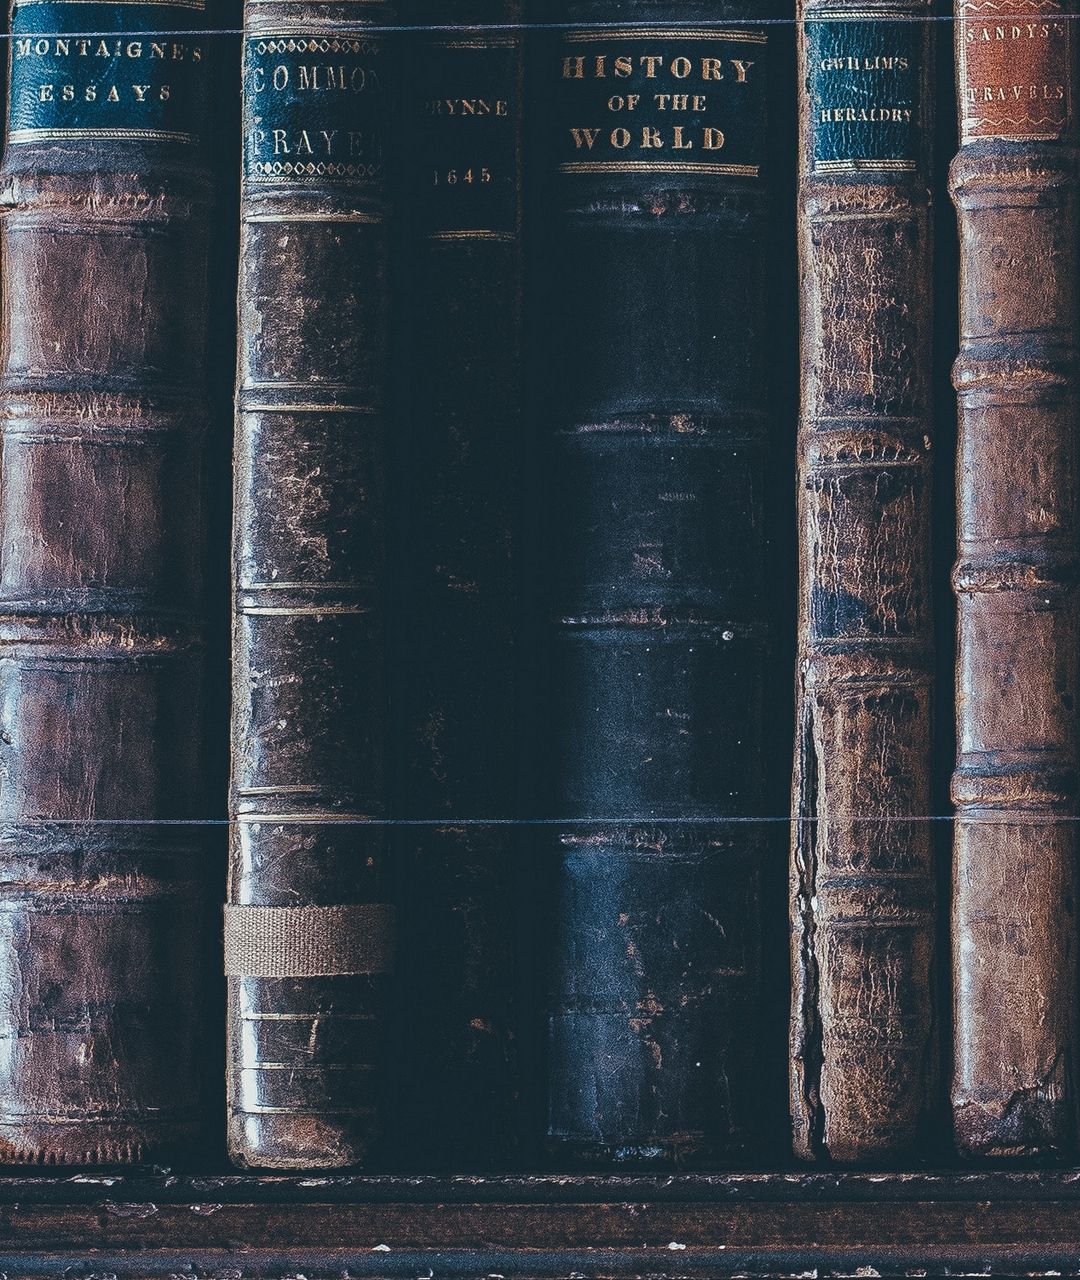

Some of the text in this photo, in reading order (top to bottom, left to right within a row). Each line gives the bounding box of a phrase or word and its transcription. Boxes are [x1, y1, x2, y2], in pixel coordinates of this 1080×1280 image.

[562, 55, 755, 83] HISTORY
[39, 84, 171, 103] ESSAYS
[607, 93, 707, 112] OF THE
[967, 84, 1064, 102] TRAVELS
[820, 107, 912, 123] HERALDRY
[569, 125, 726, 150] WORLD
[433, 166, 492, 187] 1645
